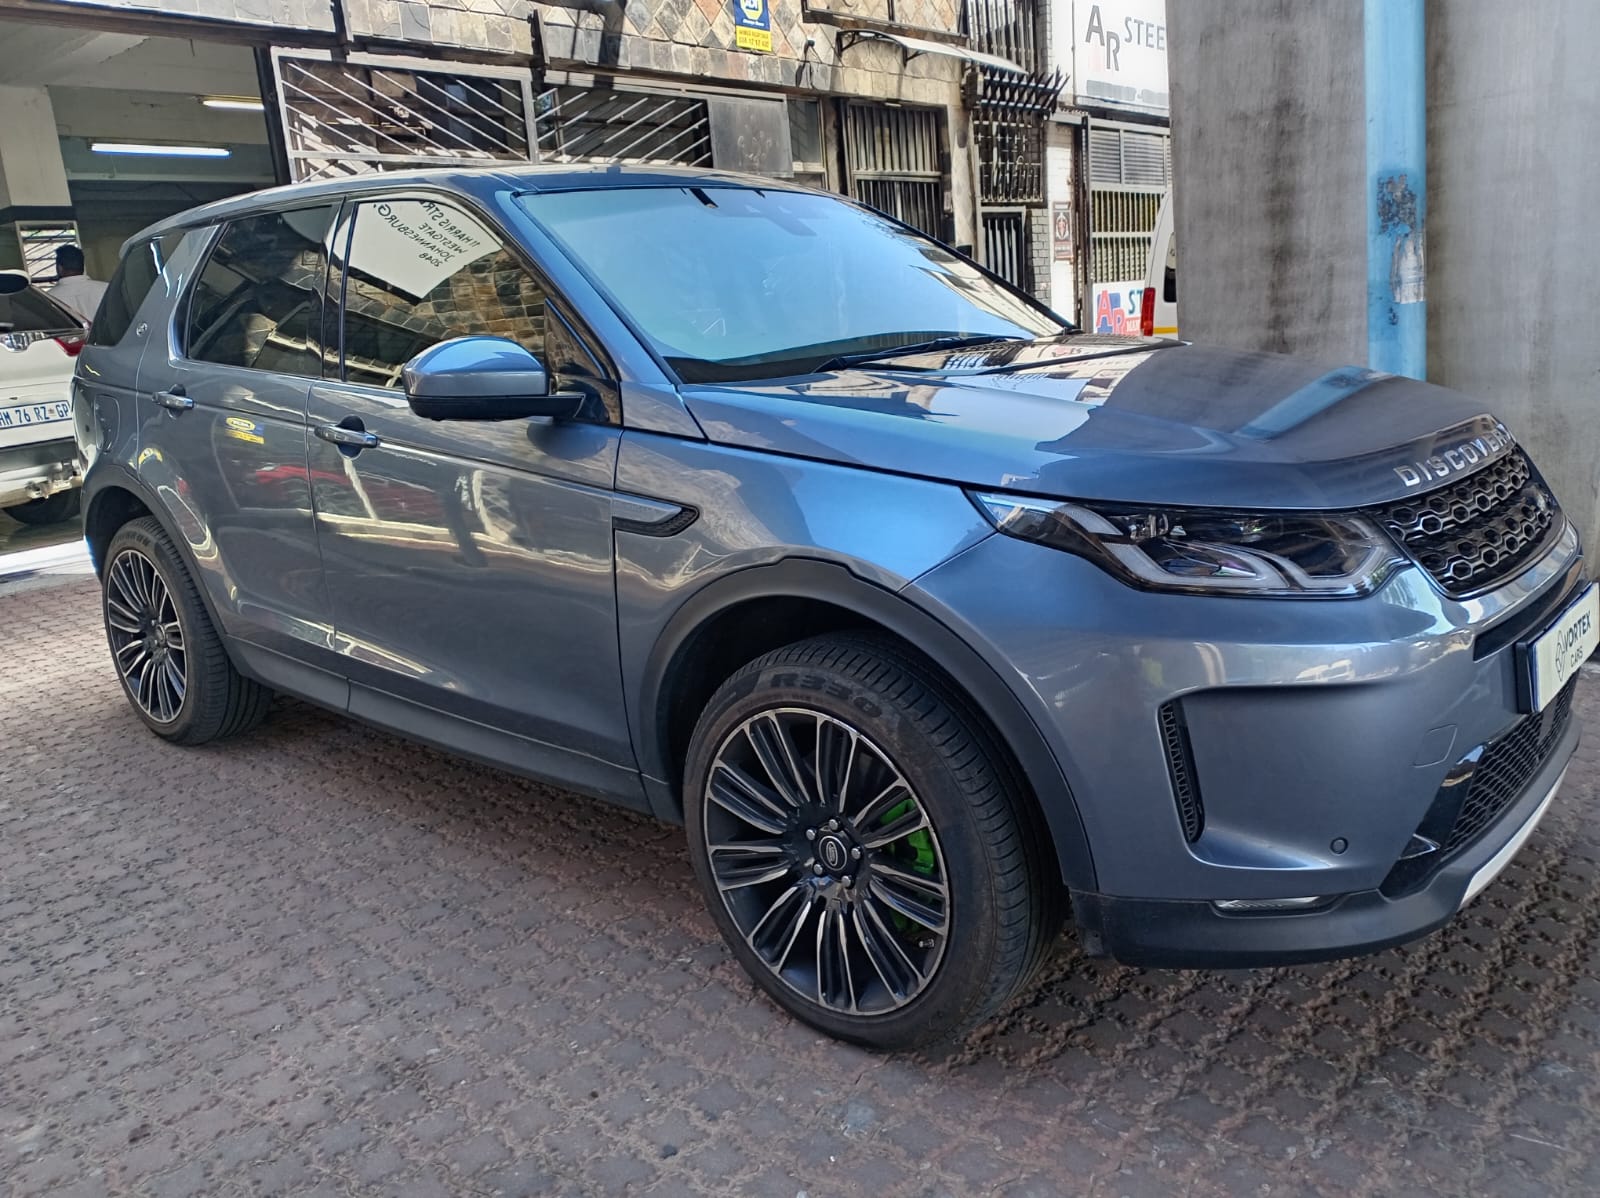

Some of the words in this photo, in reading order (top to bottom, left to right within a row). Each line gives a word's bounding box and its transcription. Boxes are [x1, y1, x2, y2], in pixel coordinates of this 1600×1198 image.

[15, 409, 31, 423] 76
[34, 406, 50, 421] RZ
[55, 403, 69, 418] GP
[1393, 424, 1513, 487] DISCOVERY
[1563, 610, 1592, 651] VORTEX
[1570, 646, 1584, 667] CARS
